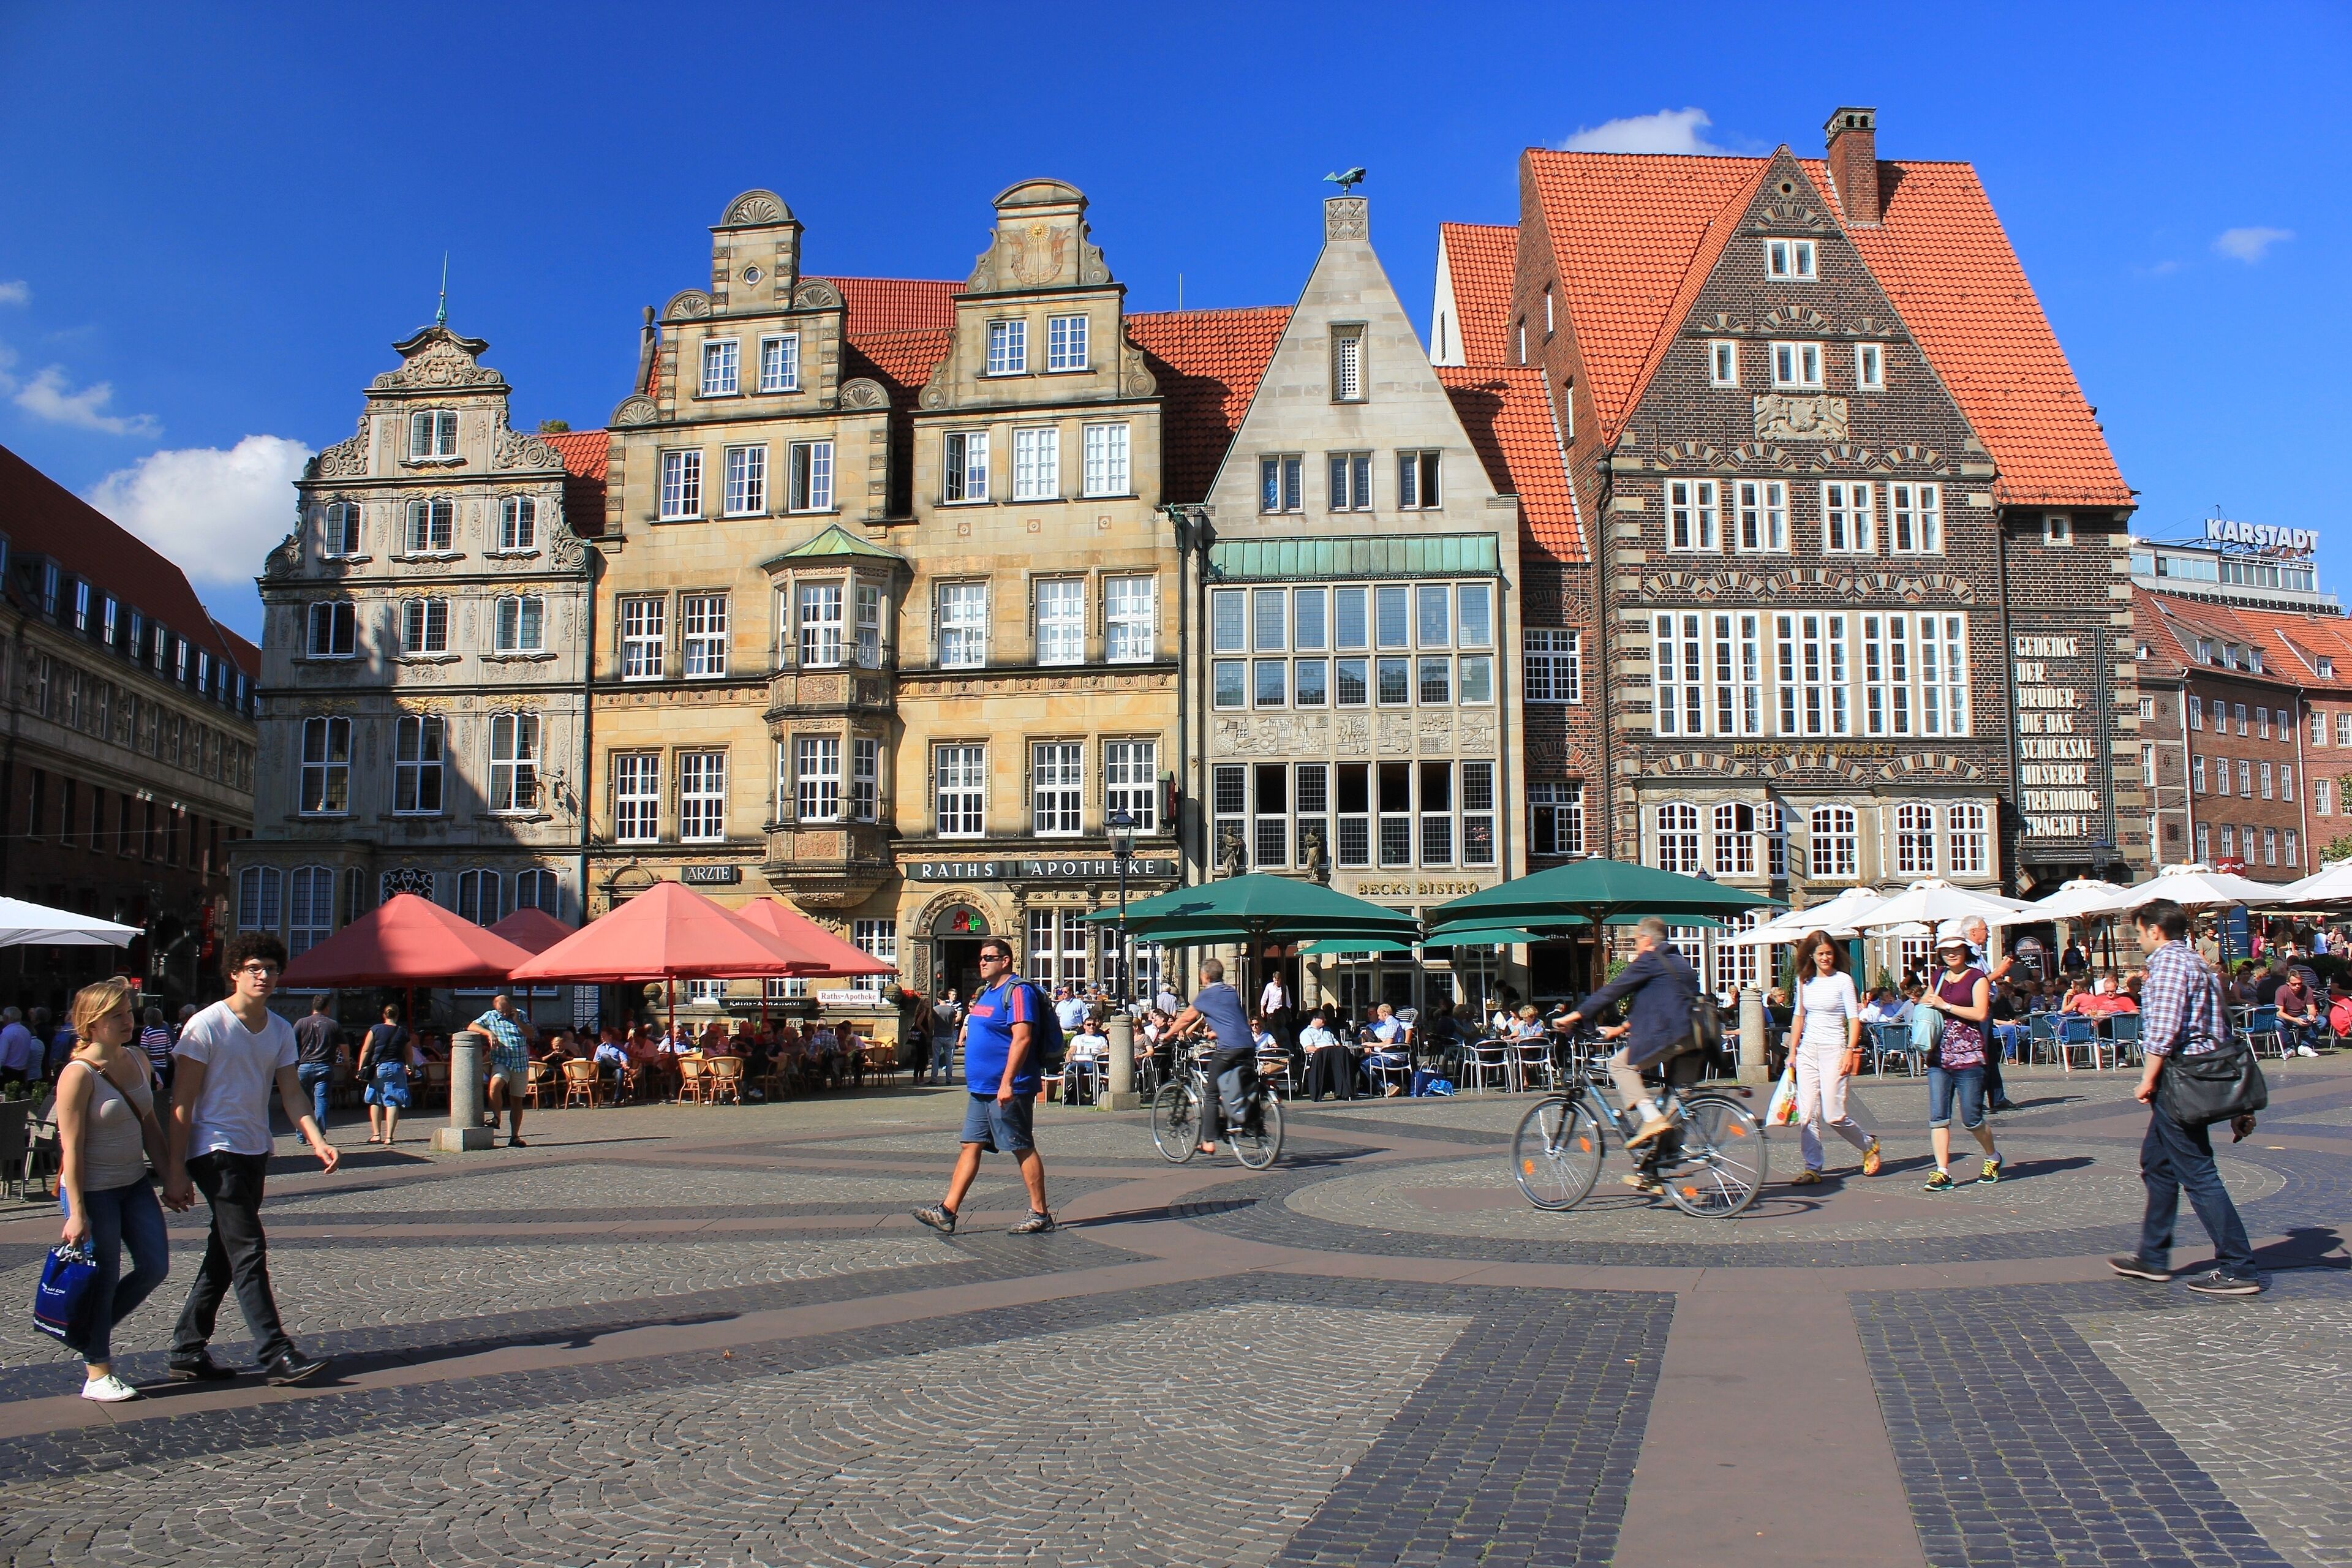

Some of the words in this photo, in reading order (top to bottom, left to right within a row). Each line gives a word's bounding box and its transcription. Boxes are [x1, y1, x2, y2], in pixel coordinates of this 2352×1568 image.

[2206, 519, 2318, 551] KARSTADT
[2015, 637, 2079, 657] GEDENKE
[2016, 663, 2045, 682] DER
[2018, 685, 2082, 709] BRÜDER,
[2019, 714, 2042, 733] DIE
[2046, 714, 2073, 733] DAS
[1799, 743, 1826, 755] AM
[1834, 744, 1897, 755] MARKT
[2021, 739, 2095, 759] SCHICKSAL
[2022, 764, 2087, 785] UNSERER
[2023, 790, 2098, 810] TRENNUNG
[687, 867, 729, 880] ÄRZTE
[922, 863, 993, 877] RATHS
[1031, 860, 1155, 876] APOTHEKE
[1418, 881, 1479, 894] BISTRO
[821, 992, 876, 1001] Raths-Apotheke
